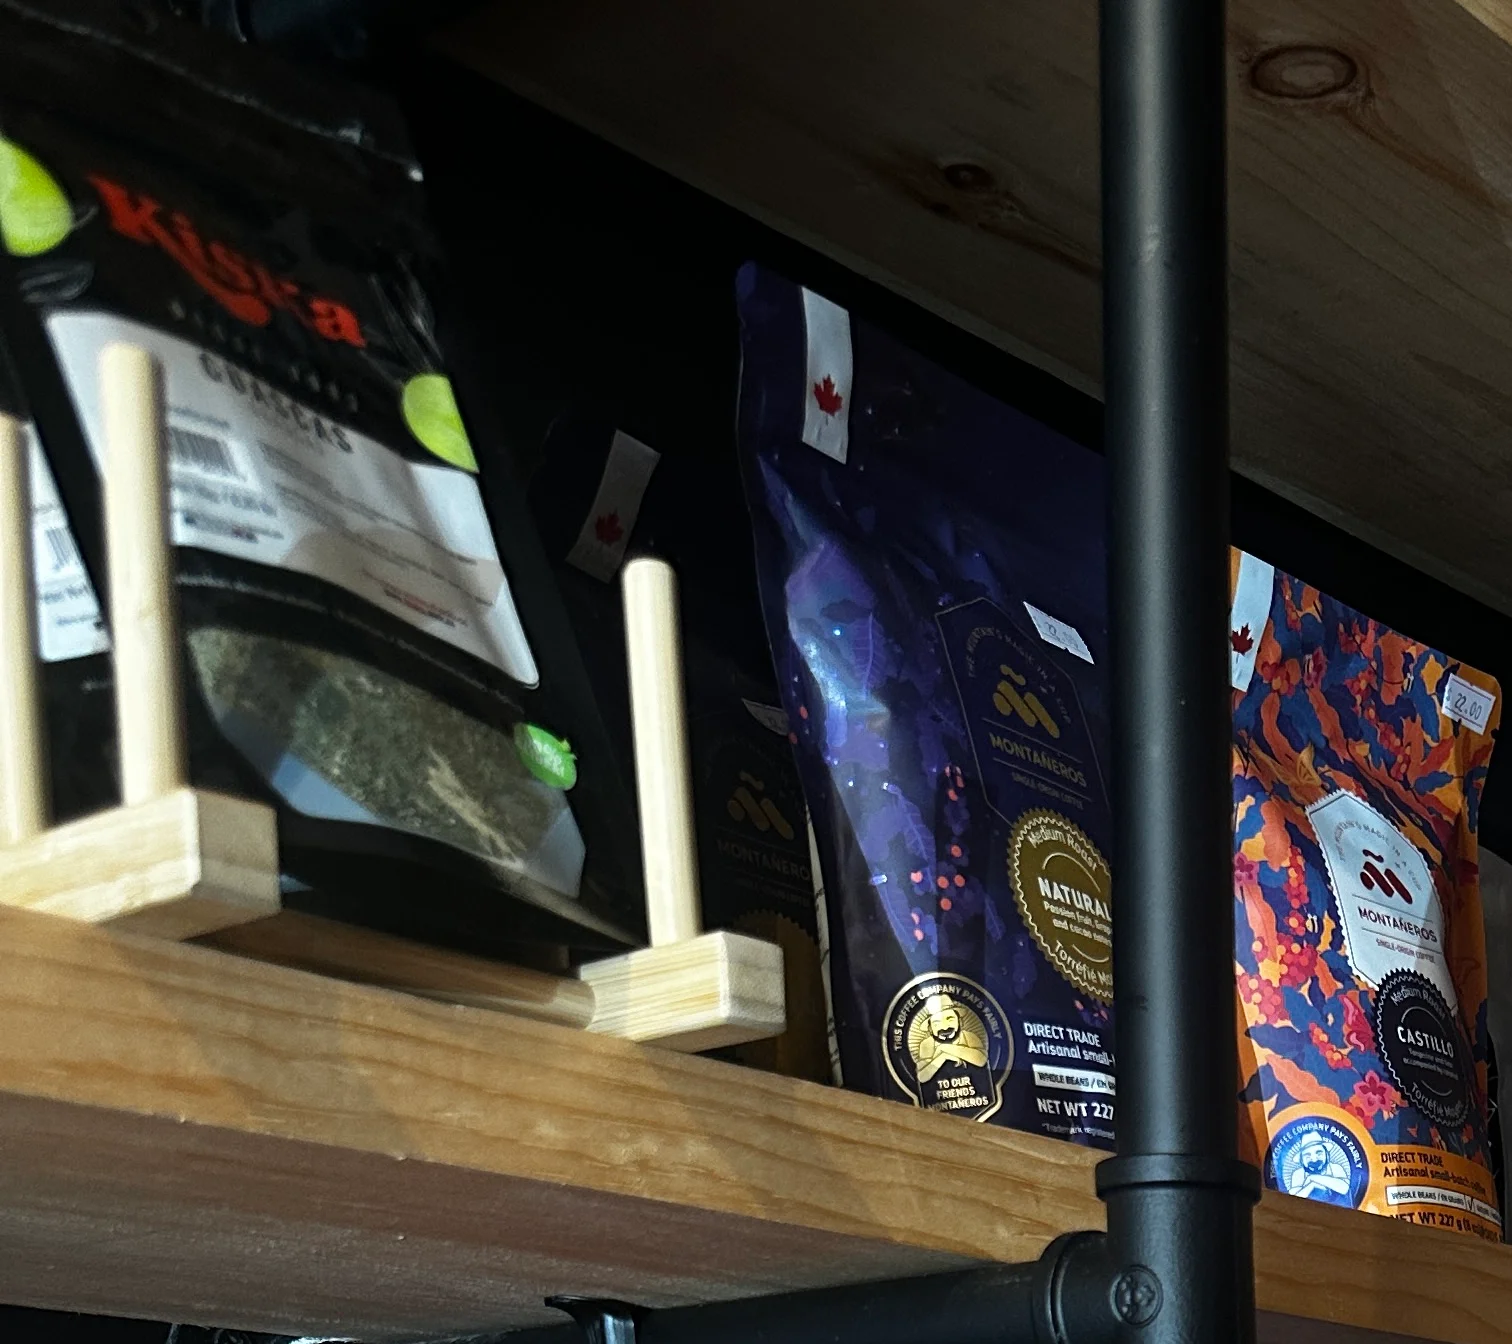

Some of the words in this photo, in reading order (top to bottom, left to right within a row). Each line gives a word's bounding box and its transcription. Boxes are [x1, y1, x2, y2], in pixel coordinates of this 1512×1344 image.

[1067, 833, 1098, 871] Roast
[1037, 877, 1112, 921] NATURAL
[1358, 906, 1438, 942] MONTAÑEROS
[895, 995, 918, 1027] COFFEE
[917, 985, 962, 1000] COMPANY
[961, 989, 985, 1012] PAYS
[983, 1006, 1002, 1039] FAIRLY
[1023, 1022, 1065, 1040] DIRECT
[1067, 1029, 1101, 1048] TRADE
[1397, 1026, 1454, 1059] CASTILLO
[1028, 1040, 1081, 1060] Artisanal
[937, 1086, 976, 1099] FRIENDS
[938, 1080, 950, 1090] TO
[951, 1076, 971, 1087] OUR
[1036, 1098, 1060, 1115] NET
[1063, 1102, 1087, 1117] WT
[1292, 1122, 1329, 1137] COMPANY
[1329, 1126, 1349, 1148] PAYS
[1346, 1141, 1363, 1169] FAIRLY
[1381, 1152, 1416, 1164] DIRECT
[1417, 1152, 1443, 1167] TRADE
[1383, 1166, 1430, 1178] Artisanal
[1419, 1212, 1437, 1225] WT
